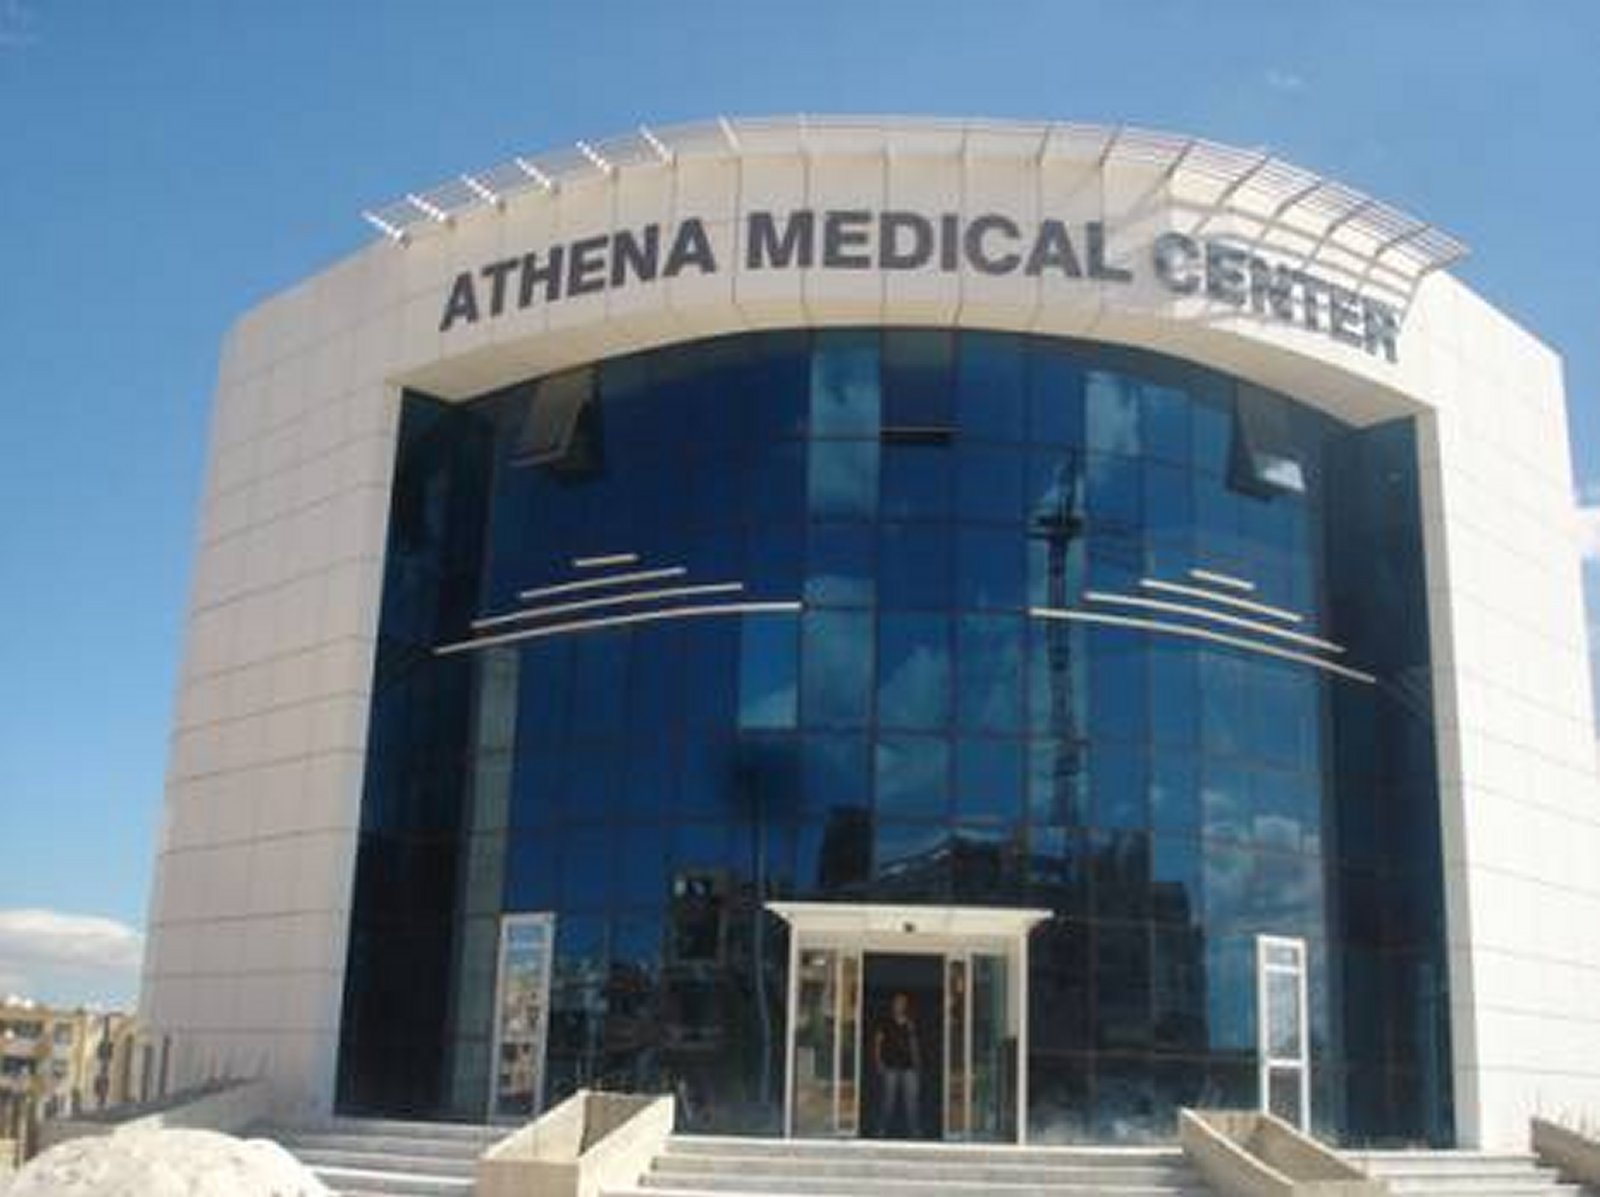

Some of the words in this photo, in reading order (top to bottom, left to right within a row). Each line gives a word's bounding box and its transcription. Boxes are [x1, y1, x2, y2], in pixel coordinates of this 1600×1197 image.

[440, 217, 716, 332] ATHENA
[746, 210, 1132, 283] MEDICAL
[1153, 232, 1401, 364] CENTER
